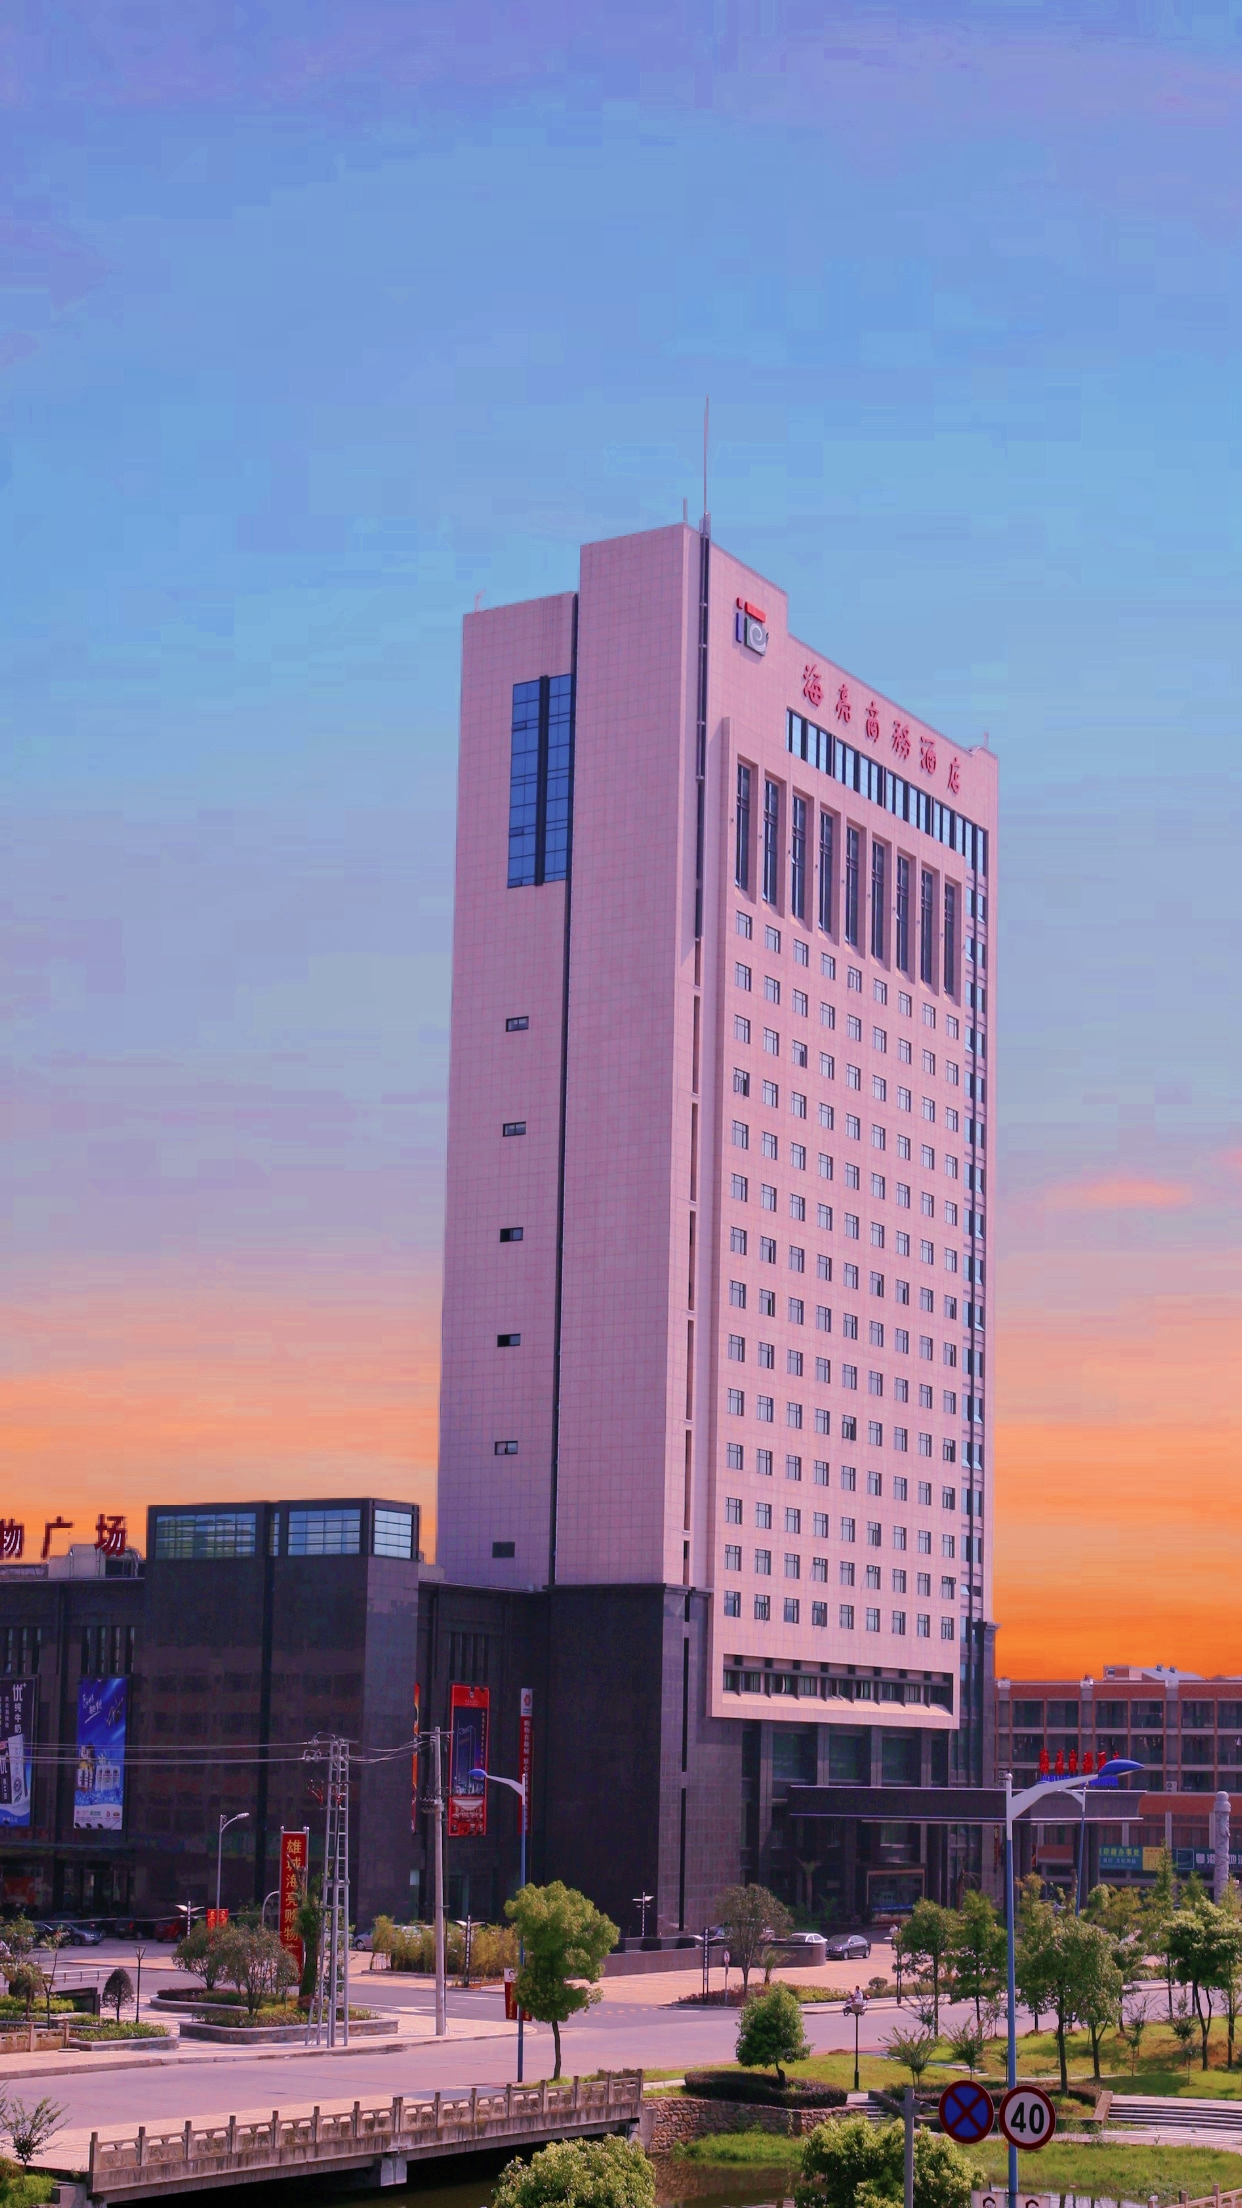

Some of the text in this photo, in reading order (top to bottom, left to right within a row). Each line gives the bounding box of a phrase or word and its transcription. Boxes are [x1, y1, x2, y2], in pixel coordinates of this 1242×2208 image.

[0, 1514, 126, 1560] 物广场
[1011, 2102, 1044, 2134] 40
